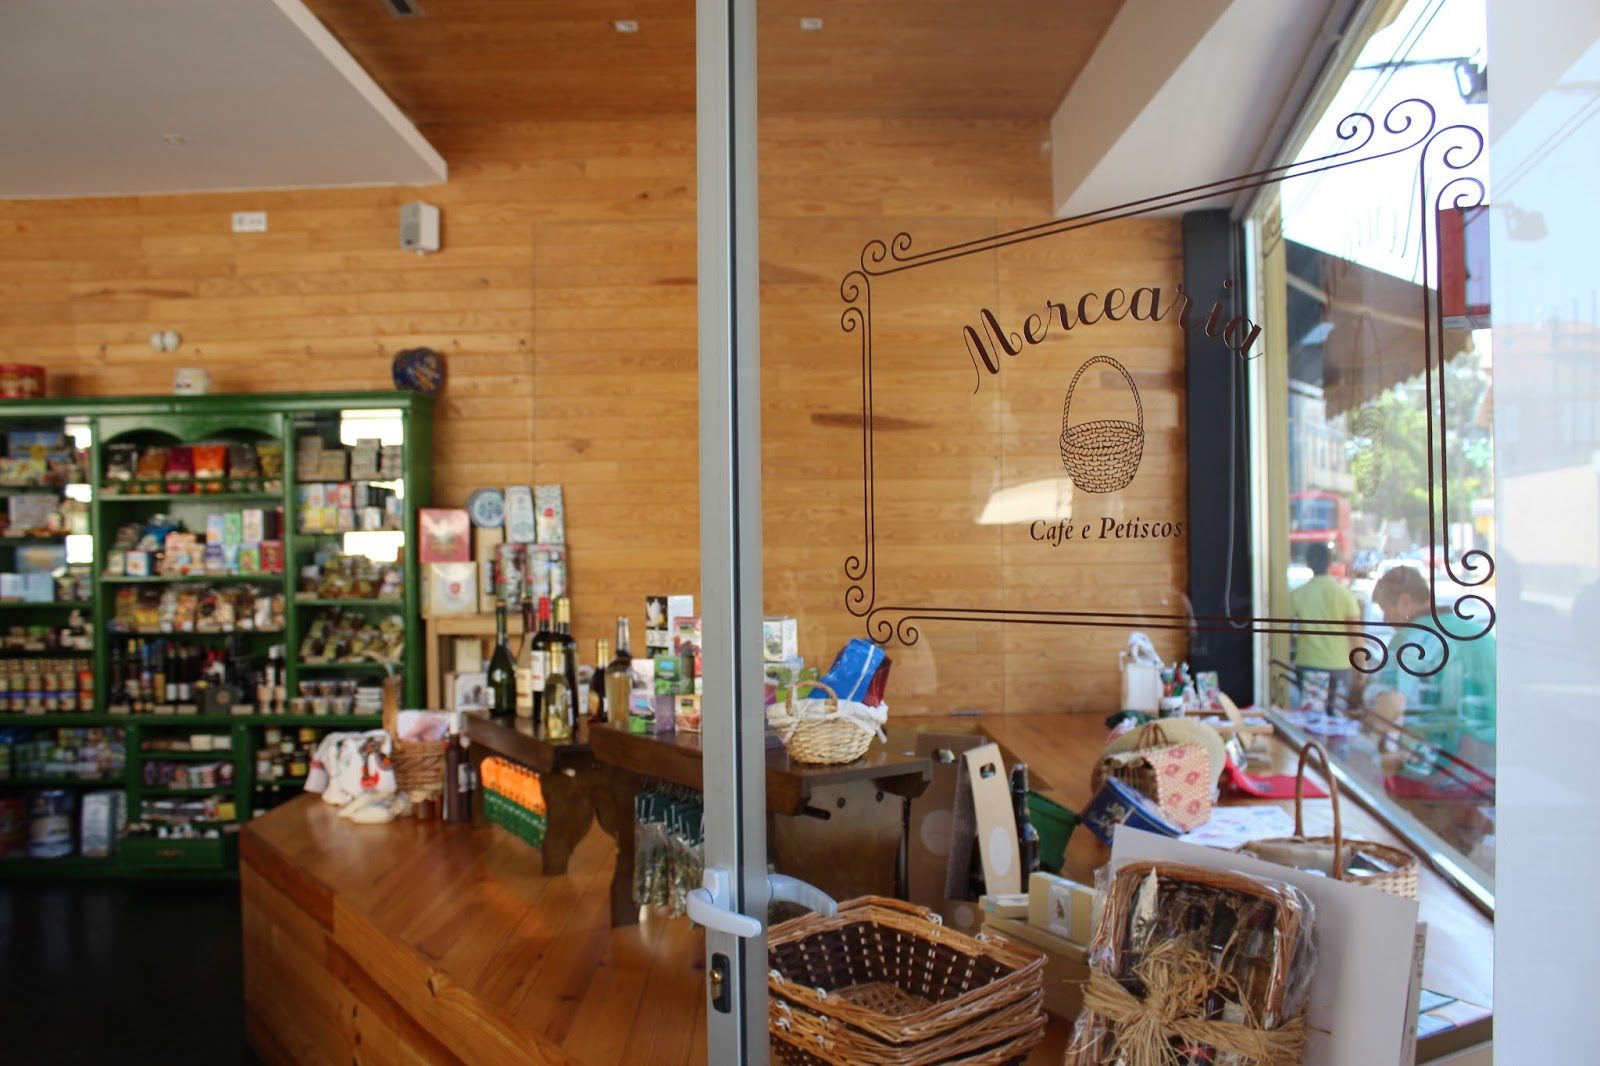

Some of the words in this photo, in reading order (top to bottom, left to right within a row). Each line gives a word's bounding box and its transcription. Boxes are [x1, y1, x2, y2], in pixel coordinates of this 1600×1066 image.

[962, 279, 1263, 394] Mercearia
[1030, 518, 1074, 547] Café
[1081, 522, 1091, 540] e
[1098, 517, 1184, 540] Petiscos
